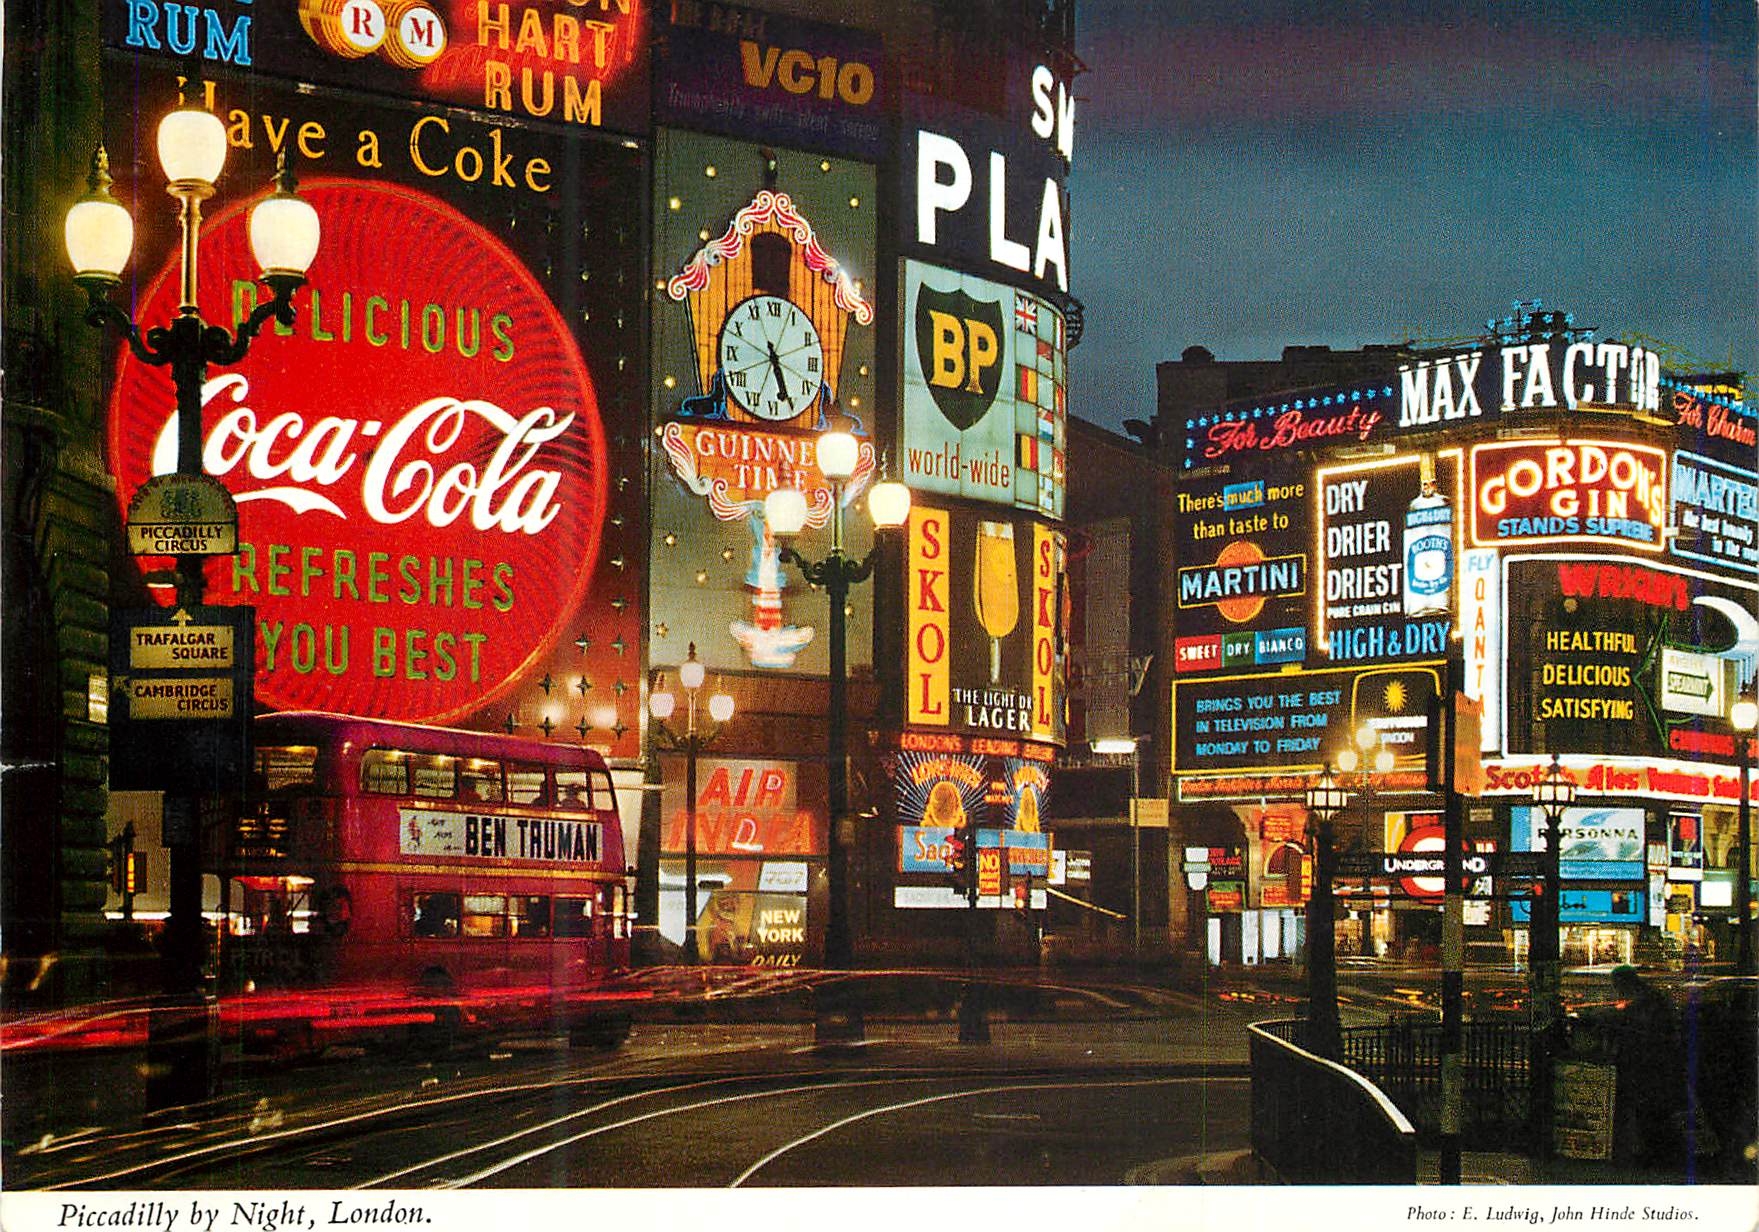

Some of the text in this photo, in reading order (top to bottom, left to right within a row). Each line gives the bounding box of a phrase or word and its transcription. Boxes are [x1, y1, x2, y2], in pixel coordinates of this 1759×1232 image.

[126, 0, 252, 65] RUM
[352, 7, 434, 47] R M
[478, 0, 614, 68] HART
[739, 40, 875, 106] VC10
[486, 60, 602, 126] RUM
[357, 129, 382, 169] a
[410, 116, 553, 192] Coke
[930, 309, 998, 394] BP
[1399, 343, 1660, 427] MAX FACTOR
[1204, 405, 1383, 458] For Beauty
[152, 373, 575, 535] Coca-Cola
[695, 431, 817, 467] GUINNE
[908, 442, 1010, 488] world-wide
[1178, 483, 1305, 513] There's much more
[1327, 480, 1368, 515] DRY
[1481, 446, 1662, 527] GORDON'S
[1551, 489, 1628, 518] GIN
[141, 526, 223, 539] PICCADILLY
[1194, 514, 1289, 540] than taste to
[1327, 521, 1390, 559] DRIER
[1498, 517, 1580, 538] STANDS
[155, 539, 207, 552] CIRCUS
[233, 542, 515, 612] REFRESHES
[1181, 561, 1298, 601] MARTINI
[1327, 563, 1402, 601] DRIEST
[915, 519, 944, 715] SKOL
[1037, 539, 1053, 726] SKOL
[136, 634, 215, 645] TRAFALGAR
[172, 647, 228, 660] SQUARE
[261, 622, 488, 682] YOU BEST
[1179, 644, 1218, 661] SWEET
[1227, 641, 1250, 658] DRY
[1259, 636, 1303, 653] BIANCO
[1328, 622, 1451, 661] HIGH & DRY
[1474, 577, 1485, 718] QANTA
[1547, 631, 1637, 654] HEALTHFUL
[1543, 664, 1631, 686] DELICIOUS
[135, 685, 217, 698] CAMBRIDGE
[177, 699, 228, 711] CIRCUS
[952, 688, 979, 704] THE
[984, 691, 1015, 708] LIGHT
[1196, 690, 1341, 713] BRINGS YOU THE BEST
[968, 705, 1030, 732] LAGER
[1196, 714, 1327, 733] IN TELEVISION FROM
[1542, 699, 1634, 720] SATISFYING
[1196, 737, 1320, 756] MONDAY TO FRIDAY
[700, 767, 786, 807] AIR
[466, 816, 506, 856] BEN
[517, 819, 598, 861] TRUMAN
[1538, 828, 1638, 840] PRSONNA
[1384, 857, 1486, 873] UNDERGRND
[761, 910, 800, 924] NEW
[758, 928, 804, 943] YORK
